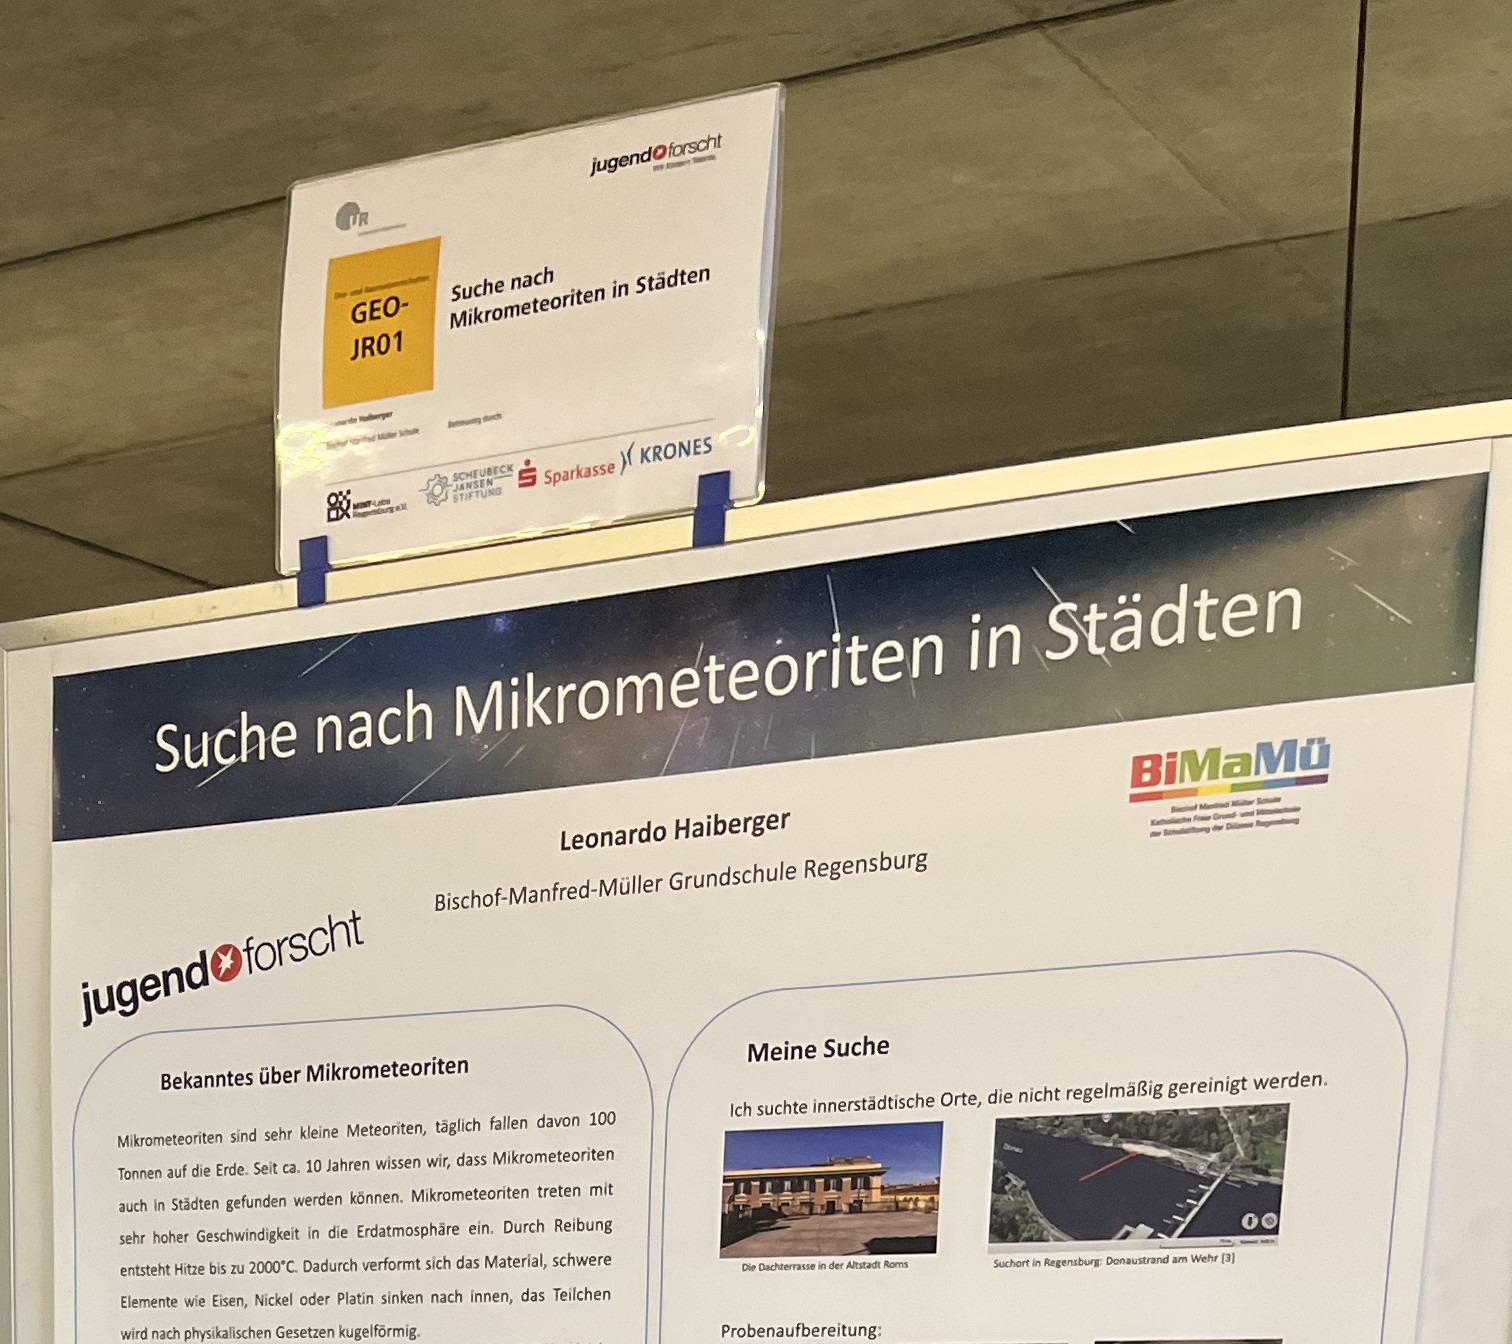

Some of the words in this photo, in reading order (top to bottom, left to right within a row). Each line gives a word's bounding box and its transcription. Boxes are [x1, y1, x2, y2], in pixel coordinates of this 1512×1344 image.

[590, 147, 652, 177] jugend
[668, 133, 723, 158] forscht
[450, 287, 606, 330] Mikrometeoriten
[612, 279, 629, 299] in
[635, 267, 710, 295] Städten
[451, 277, 505, 303] Suche
[510, 265, 554, 291] nach
[351, 296, 409, 323] GEO-
[350, 330, 403, 361] JR01
[640, 437, 712, 464] KRONES
[453, 464, 514, 482] SCHEUBECK
[453, 478, 494, 493] JANSEN
[544, 461, 616, 486] Sparkasse
[452, 487, 502, 504] STIFTUNG
[154, 711, 297, 774] Suche
[315, 690, 433, 755] nach
[454, 630, 944, 738] Mikrometeoriten
[969, 614, 1021, 671] in
[1045, 584, 1303, 662] Städten
[1130, 737, 1331, 789] BiMaMü
[560, 820, 667, 852] Leonardo
[674, 811, 791, 841] Haiberger
[434, 874, 664, 912] Bischof-Manfred-Müller
[669, 860, 797, 891] Grundschule
[804, 850, 928, 881] Regensburg
[81, 950, 210, 1027] jugend
[243, 910, 364, 975] forscht
[747, 1040, 817, 1063] Meine
[823, 1035, 890, 1059] Suche
[161, 1070, 254, 1091] Bekanntes
[259, 1065, 302, 1086] über
[306, 1056, 469, 1083] Mikrometeoriten
[730, 1101, 752, 1118] Ich
[756, 1099, 808, 1117] suchte
[812, 1092, 936, 1114] innerstädtische
[940, 1091, 982, 1109] Orte,
[987, 1088, 1013, 1105] die
[1018, 1085, 1061, 1104] nicht
[1066, 1079, 1164, 1104] regelmäßig
[1167, 1075, 1248, 1099] gereinigt
[1253, 1070, 1328, 1090] werden.
[117, 1130, 223, 1149] Mikrometeoriten
[230, 1127, 257, 1144] sind
[264, 1126, 293, 1142] sehr
[300, 1124, 339, 1140] kleine
[346, 1121, 427, 1138] Meteoriten,
[435, 1117, 481, 1137] täglich
[489, 1115, 528, 1132] fallen
[536, 1113, 580, 1129] davon
[589, 1110, 617, 1127] 100
[120, 1326, 148, 1341] wird
[151, 1326, 181, 1341] nach
[183, 1325, 272, 1343] physikalischen
[275, 1325, 335, 1339] Gesetzen
[338, 1323, 421, 1342] kugelförmig.
[721, 1322, 882, 1341] Probenaufbereitung:
